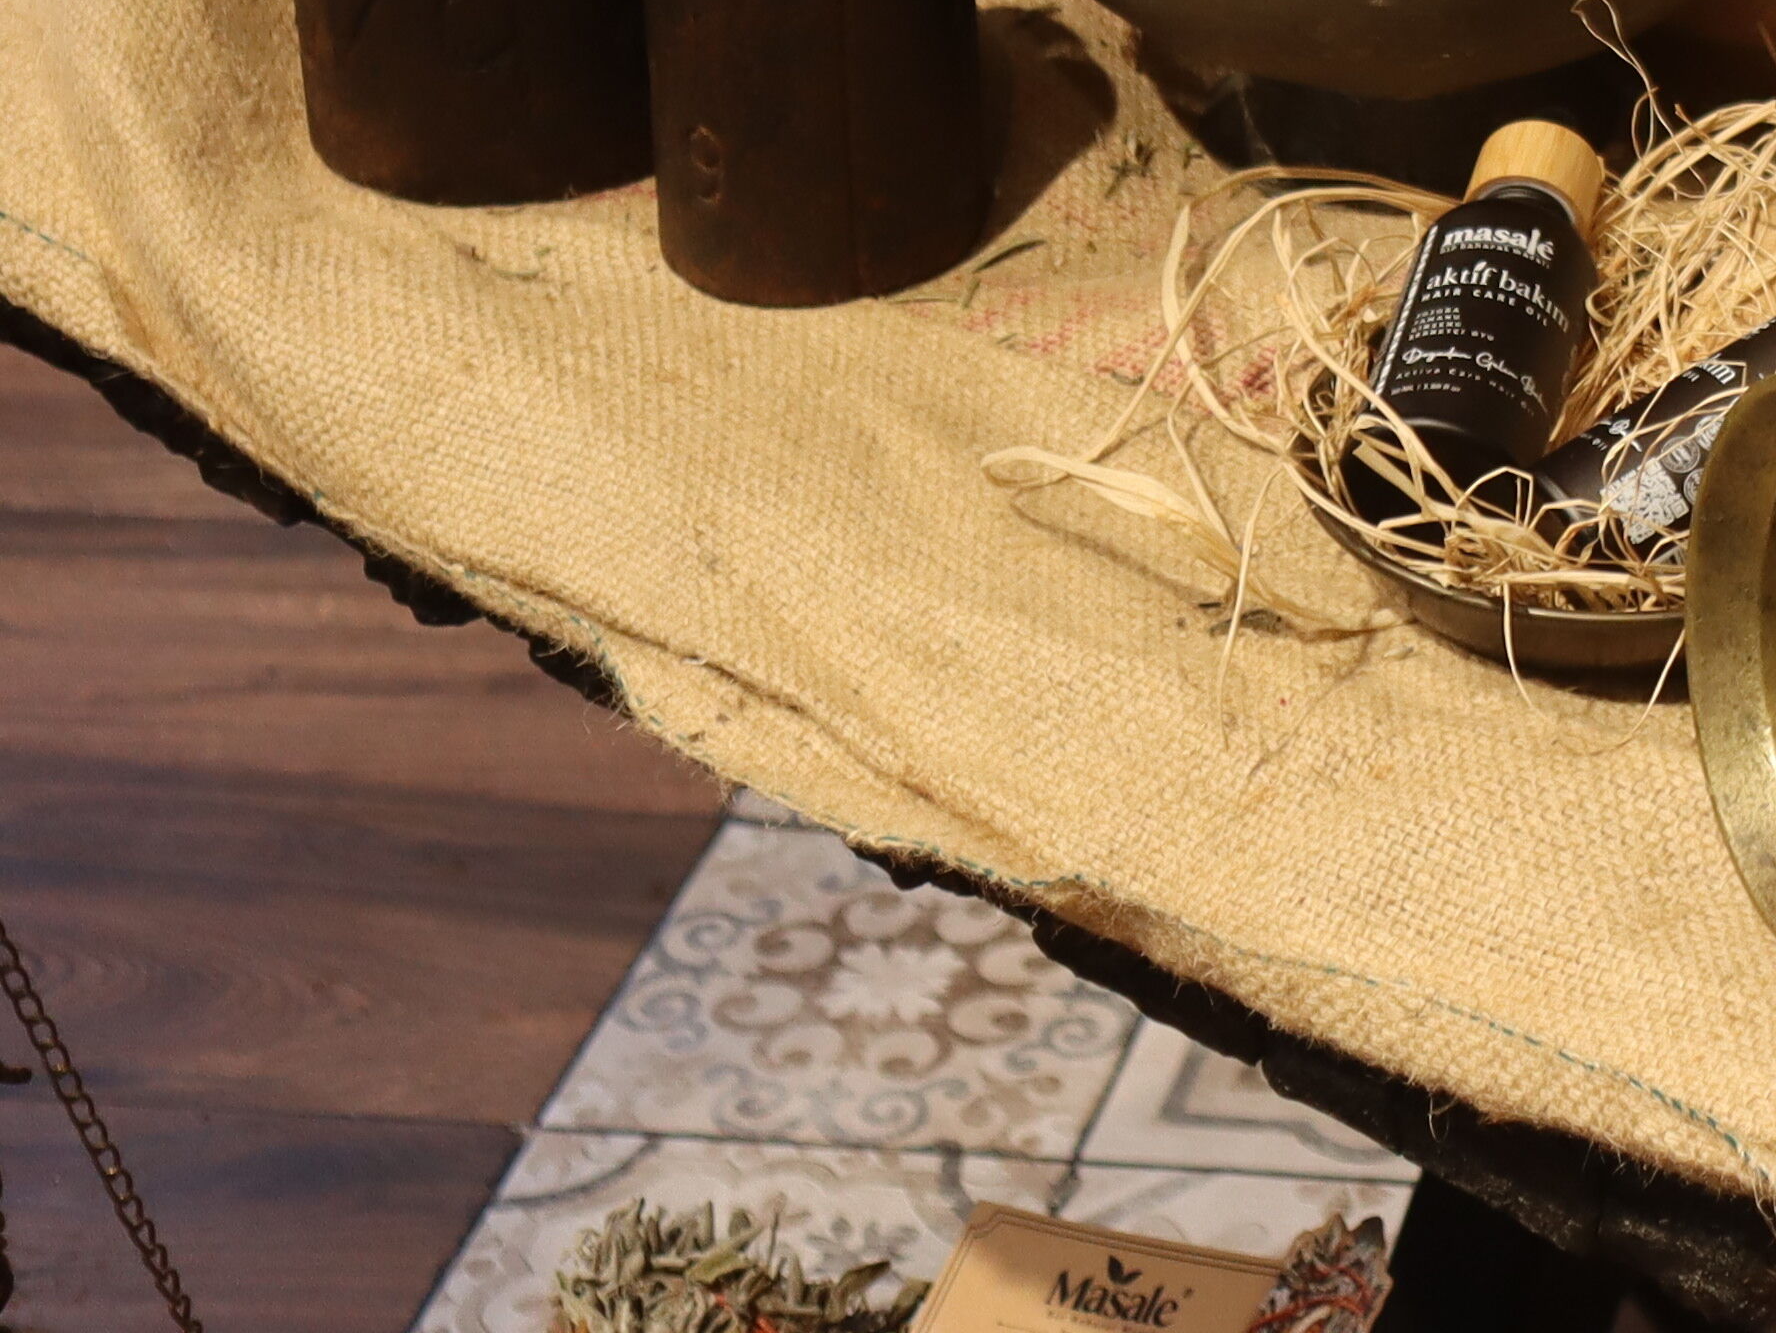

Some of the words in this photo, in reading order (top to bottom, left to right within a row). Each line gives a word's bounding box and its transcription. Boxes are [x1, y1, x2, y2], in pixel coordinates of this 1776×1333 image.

[1443, 227, 1555, 261] masalé
[1420, 287, 1463, 303] HAIR
[1472, 288, 1517, 307] CARE
[1498, 269, 1570, 334] bakım
